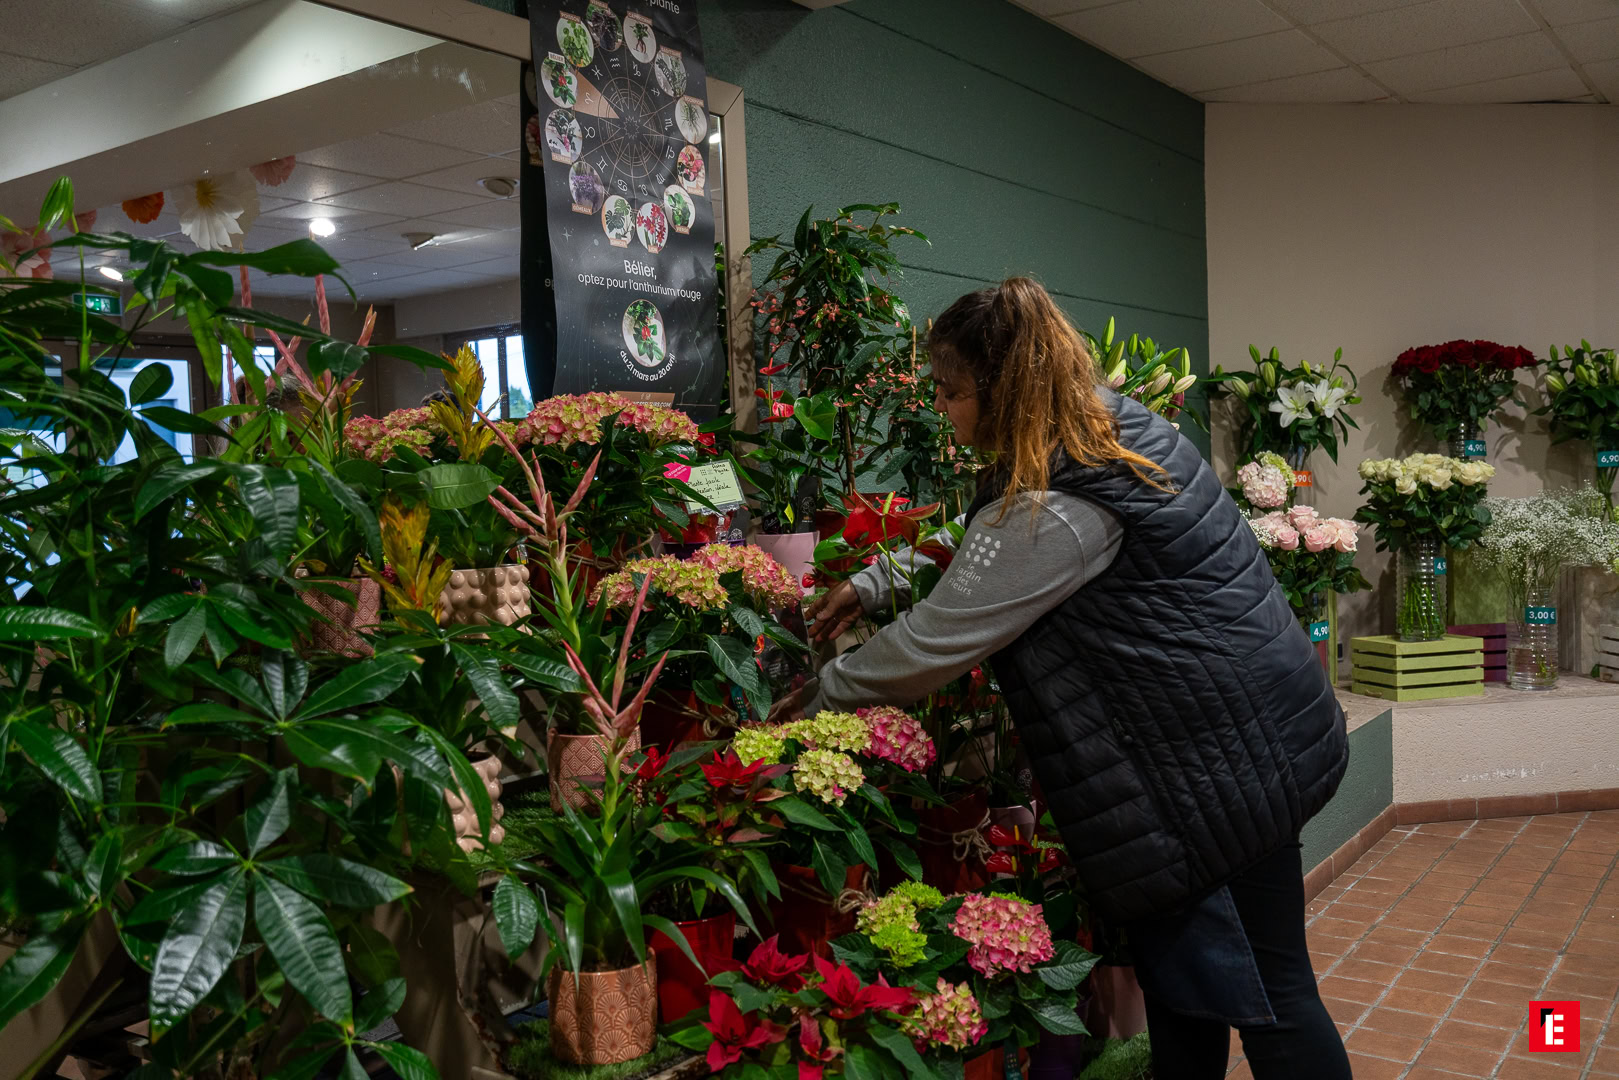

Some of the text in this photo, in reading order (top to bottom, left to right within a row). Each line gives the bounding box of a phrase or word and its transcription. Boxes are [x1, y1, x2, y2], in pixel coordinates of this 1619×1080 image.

[623, 259, 657, 280] Bélier,
[578, 273, 701, 302] optez pour l'anthurium rouge
[620, 350, 676, 382] du 21 mars au 20 avril
[956, 565, 981, 583] Jardin
[957, 576, 969, 586] des
[948, 577, 973, 596] Fleurs
[1528, 611, 1555, 620] 3,00 €
